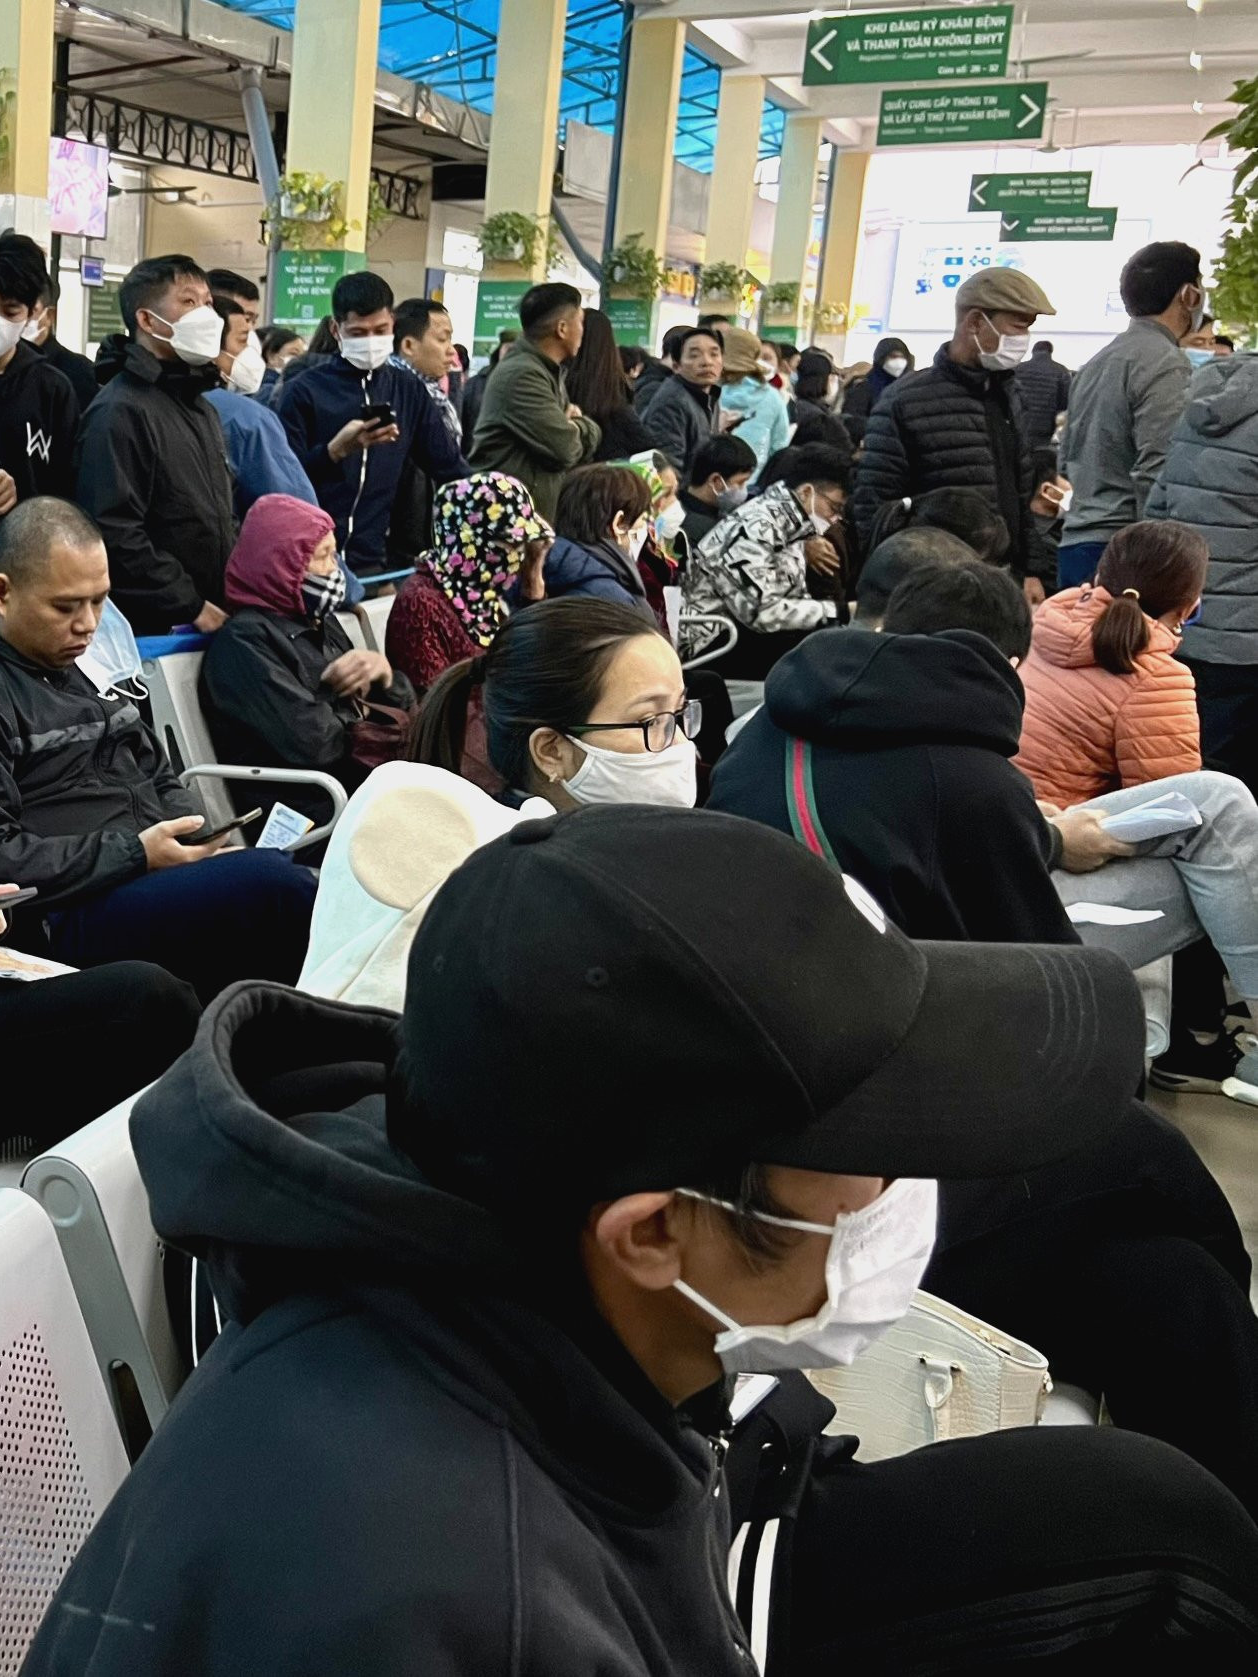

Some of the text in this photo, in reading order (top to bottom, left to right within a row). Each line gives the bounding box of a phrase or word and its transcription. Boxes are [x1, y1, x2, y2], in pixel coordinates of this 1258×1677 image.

[864, 22, 887, 34] KHU
[939, 15, 973, 30] KHÁM
[863, 38, 900, 50] THANH
[902, 35, 932, 49] TOÁN
[974, 32, 1005, 45] BHYT
